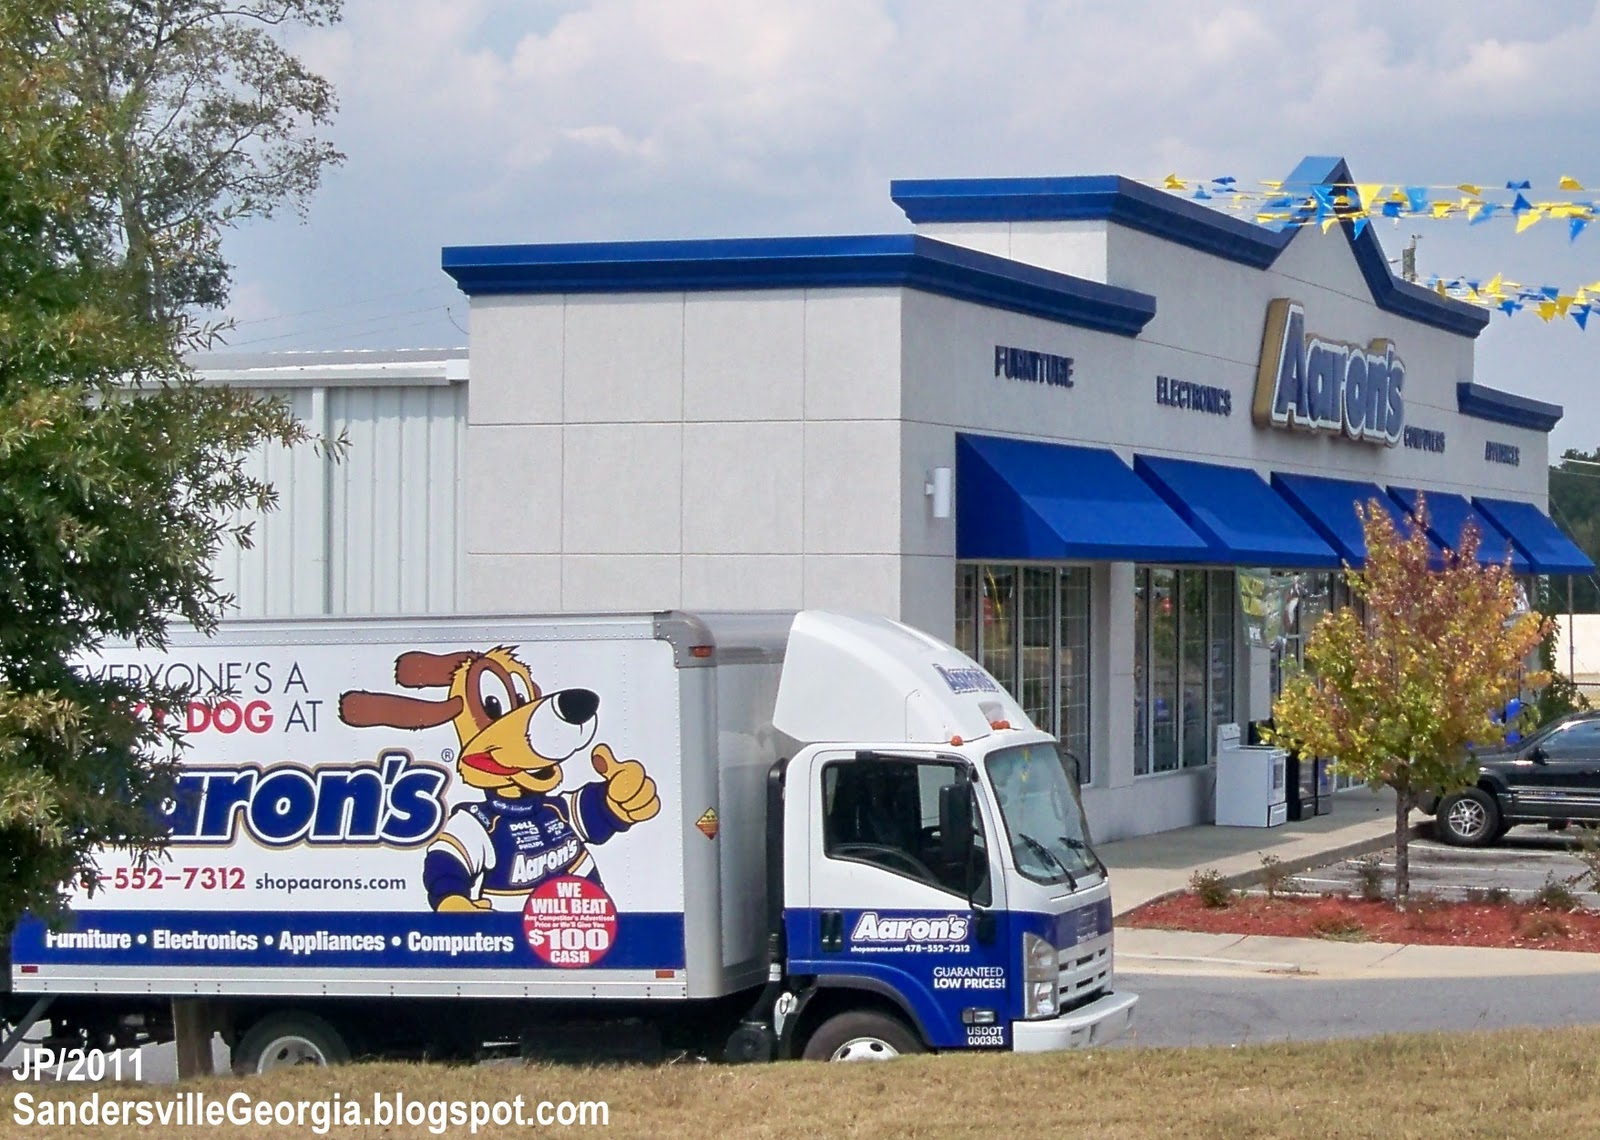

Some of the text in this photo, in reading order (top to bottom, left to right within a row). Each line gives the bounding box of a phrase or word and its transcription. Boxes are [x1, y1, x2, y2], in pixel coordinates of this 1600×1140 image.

[994, 345, 1074, 388] FURNITURE
[1266, 302, 1405, 449] Aaron's
[1156, 375, 1232, 417] ELECTRONICS
[283, 662, 309, 694] A
[186, 700, 274, 734] DOG
[284, 701, 323, 732] AT
[510, 838, 579, 884] Aaron's
[255, 873, 406, 894] shopaarons.com
[556, 882, 582, 898] WE
[531, 898, 608, 914] WILL BEAT
[851, 911, 968, 942] Aaron's
[45, 929, 514, 955] Furniture Electronics Appliances Computers
[528, 928, 609, 950] $100
[904, 944, 971, 953] 478-552-7312
[550, 950, 590, 963] CASH
[933, 966, 1004, 978] GUARANTEED
[934, 978, 1006, 989] LOW PRICES!
[967, 1026, 1004, 1036] USDOT
